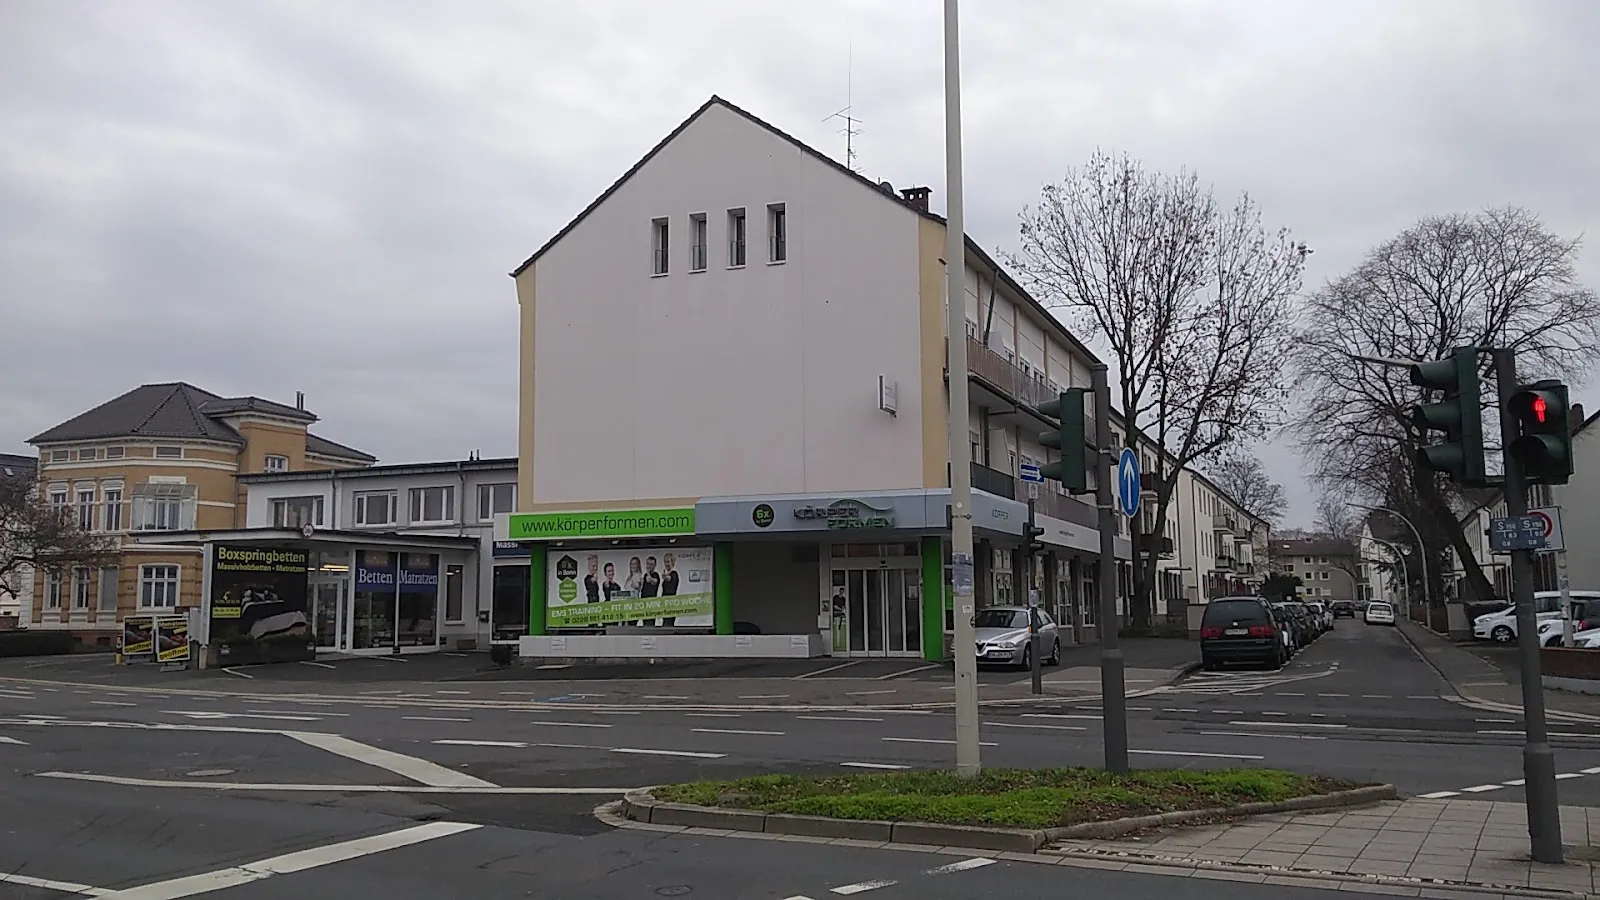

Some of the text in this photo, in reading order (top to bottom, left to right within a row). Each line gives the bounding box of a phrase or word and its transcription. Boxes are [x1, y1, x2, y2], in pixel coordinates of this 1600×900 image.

[756, 509, 770, 519] 6x
[522, 514, 690, 534] www.körperformen.com
[1497, 522, 1504, 530] S
[1523, 520, 1531, 528] S
[218, 546, 306, 564] Boxspringbetten
[216, 562, 272, 572] Massivholzbetten
[358, 568, 438, 585] Betten Matratzen
[568, 606, 602, 616] TRAINING
[634, 602, 645, 610] 20
